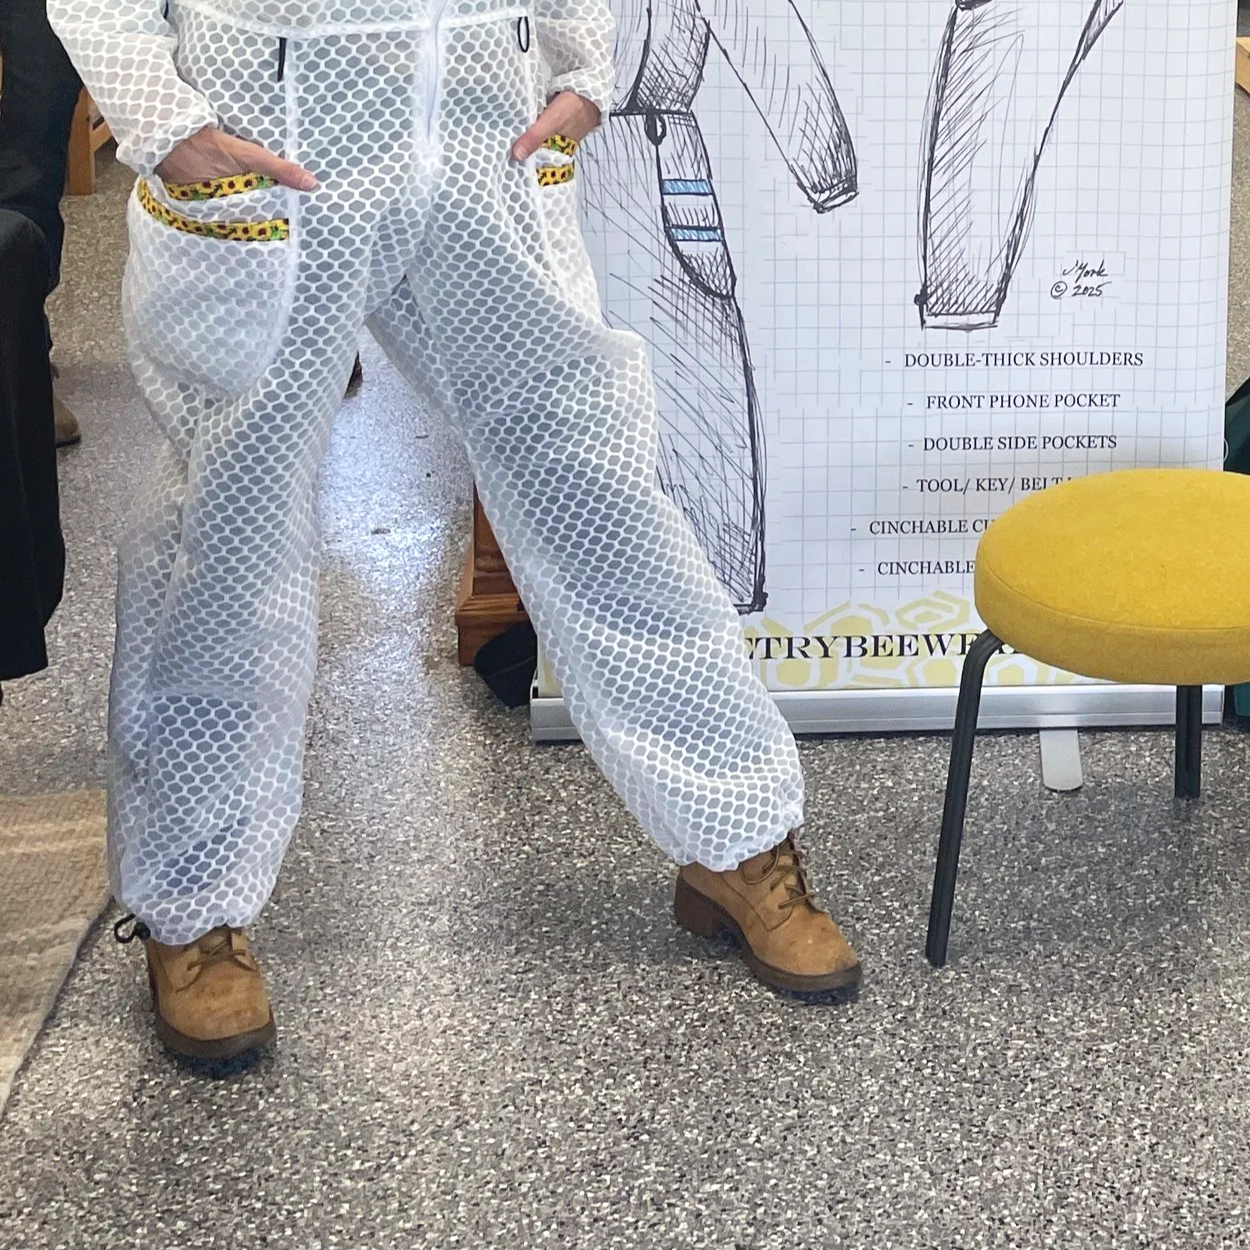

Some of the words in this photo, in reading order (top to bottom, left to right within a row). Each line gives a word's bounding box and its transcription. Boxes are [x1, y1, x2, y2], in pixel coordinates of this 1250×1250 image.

[1071, 280, 1113, 298] 2025
[904, 352, 1036, 368] DOUBLE-THICK
[1039, 351, 1144, 367] SHOULDERS
[926, 395, 986, 410] FRONT
[989, 393, 1050, 409] PHONE
[1054, 392, 1122, 408] POCKET
[923, 436, 994, 452] DOUBLE
[997, 435, 1038, 450] SIDE
[1041, 434, 1118, 450] POCKETS
[869, 519, 969, 535] CINCHABLE
[877, 560, 976, 574] CINCHABLE
